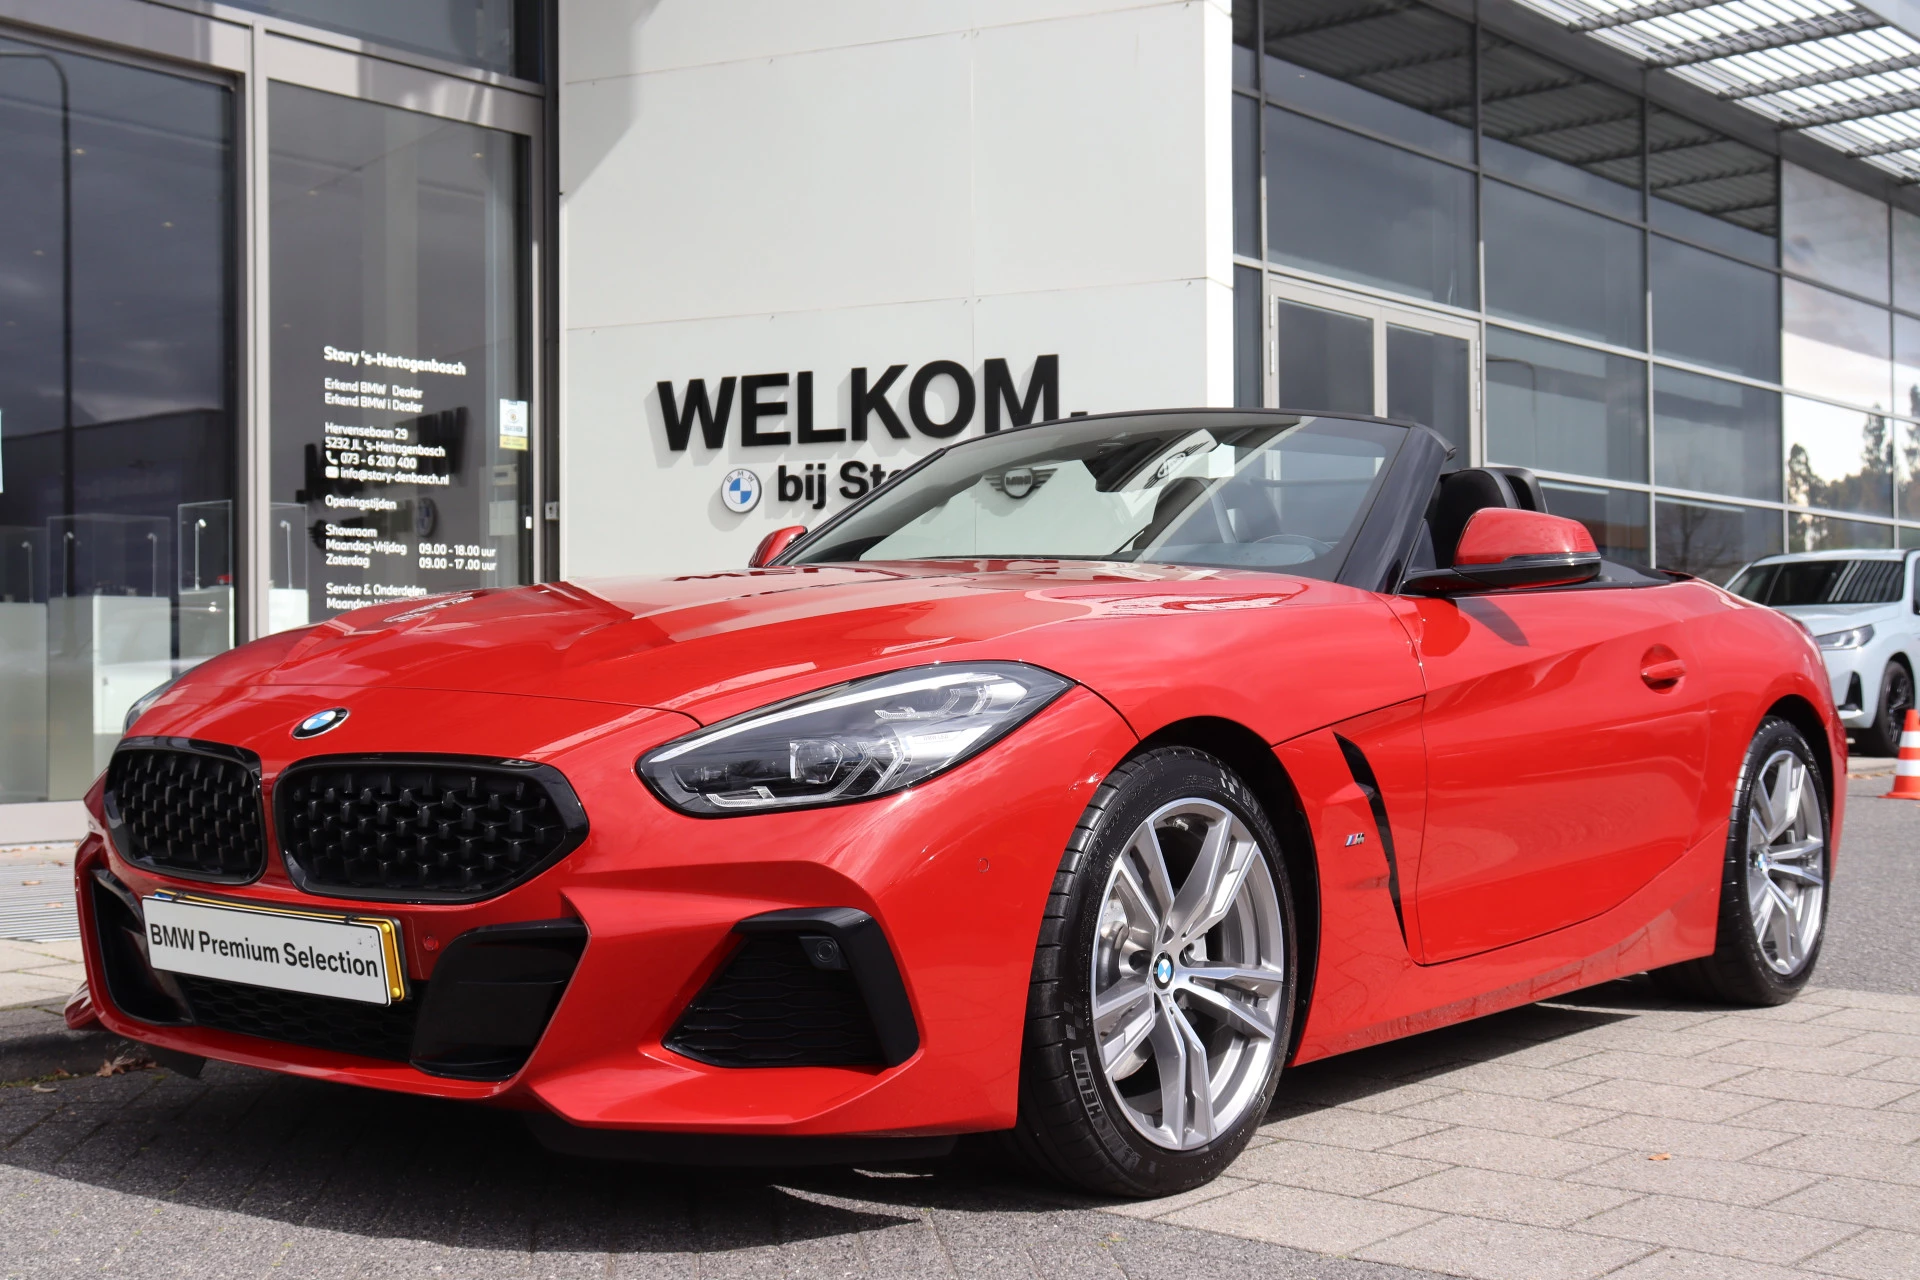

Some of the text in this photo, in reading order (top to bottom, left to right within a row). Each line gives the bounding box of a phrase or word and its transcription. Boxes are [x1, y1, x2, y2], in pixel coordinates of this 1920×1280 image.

[324, 346, 466, 376] Story 's-Hertogenbosch
[324, 377, 424, 399] Erkend BMW Dealer
[324, 392, 424, 413] Erkend BMW i Dealer
[657, 354, 1088, 451] WELKOM
[325, 421, 409, 441] Hervensebaan 29
[325, 436, 350, 450] 5232
[350, 439, 362, 451] JL
[340, 452, 360, 465] 073
[368, 455, 375, 467] 6
[376, 456, 396, 468] 200
[397, 457, 418, 469] 400
[340, 467, 450, 485] info@story-denbosch.nl
[778, 461, 900, 510] bij St
[325, 494, 398, 511] Openingstijden
[325, 524, 378, 538] Showroom
[326, 539, 408, 556] Maandag-Vrijdag
[418, 543, 447, 556] 09.00
[454, 544, 480, 557] 18.00
[481, 549, 496, 557] uur
[325, 554, 371, 569] Zaterdag
[418, 557, 447, 570] 09.00
[481, 563, 497, 571] uur
[326, 582, 427, 598] Service & Onderdelen
[150, 923, 379, 978] BMW Premium Selection
